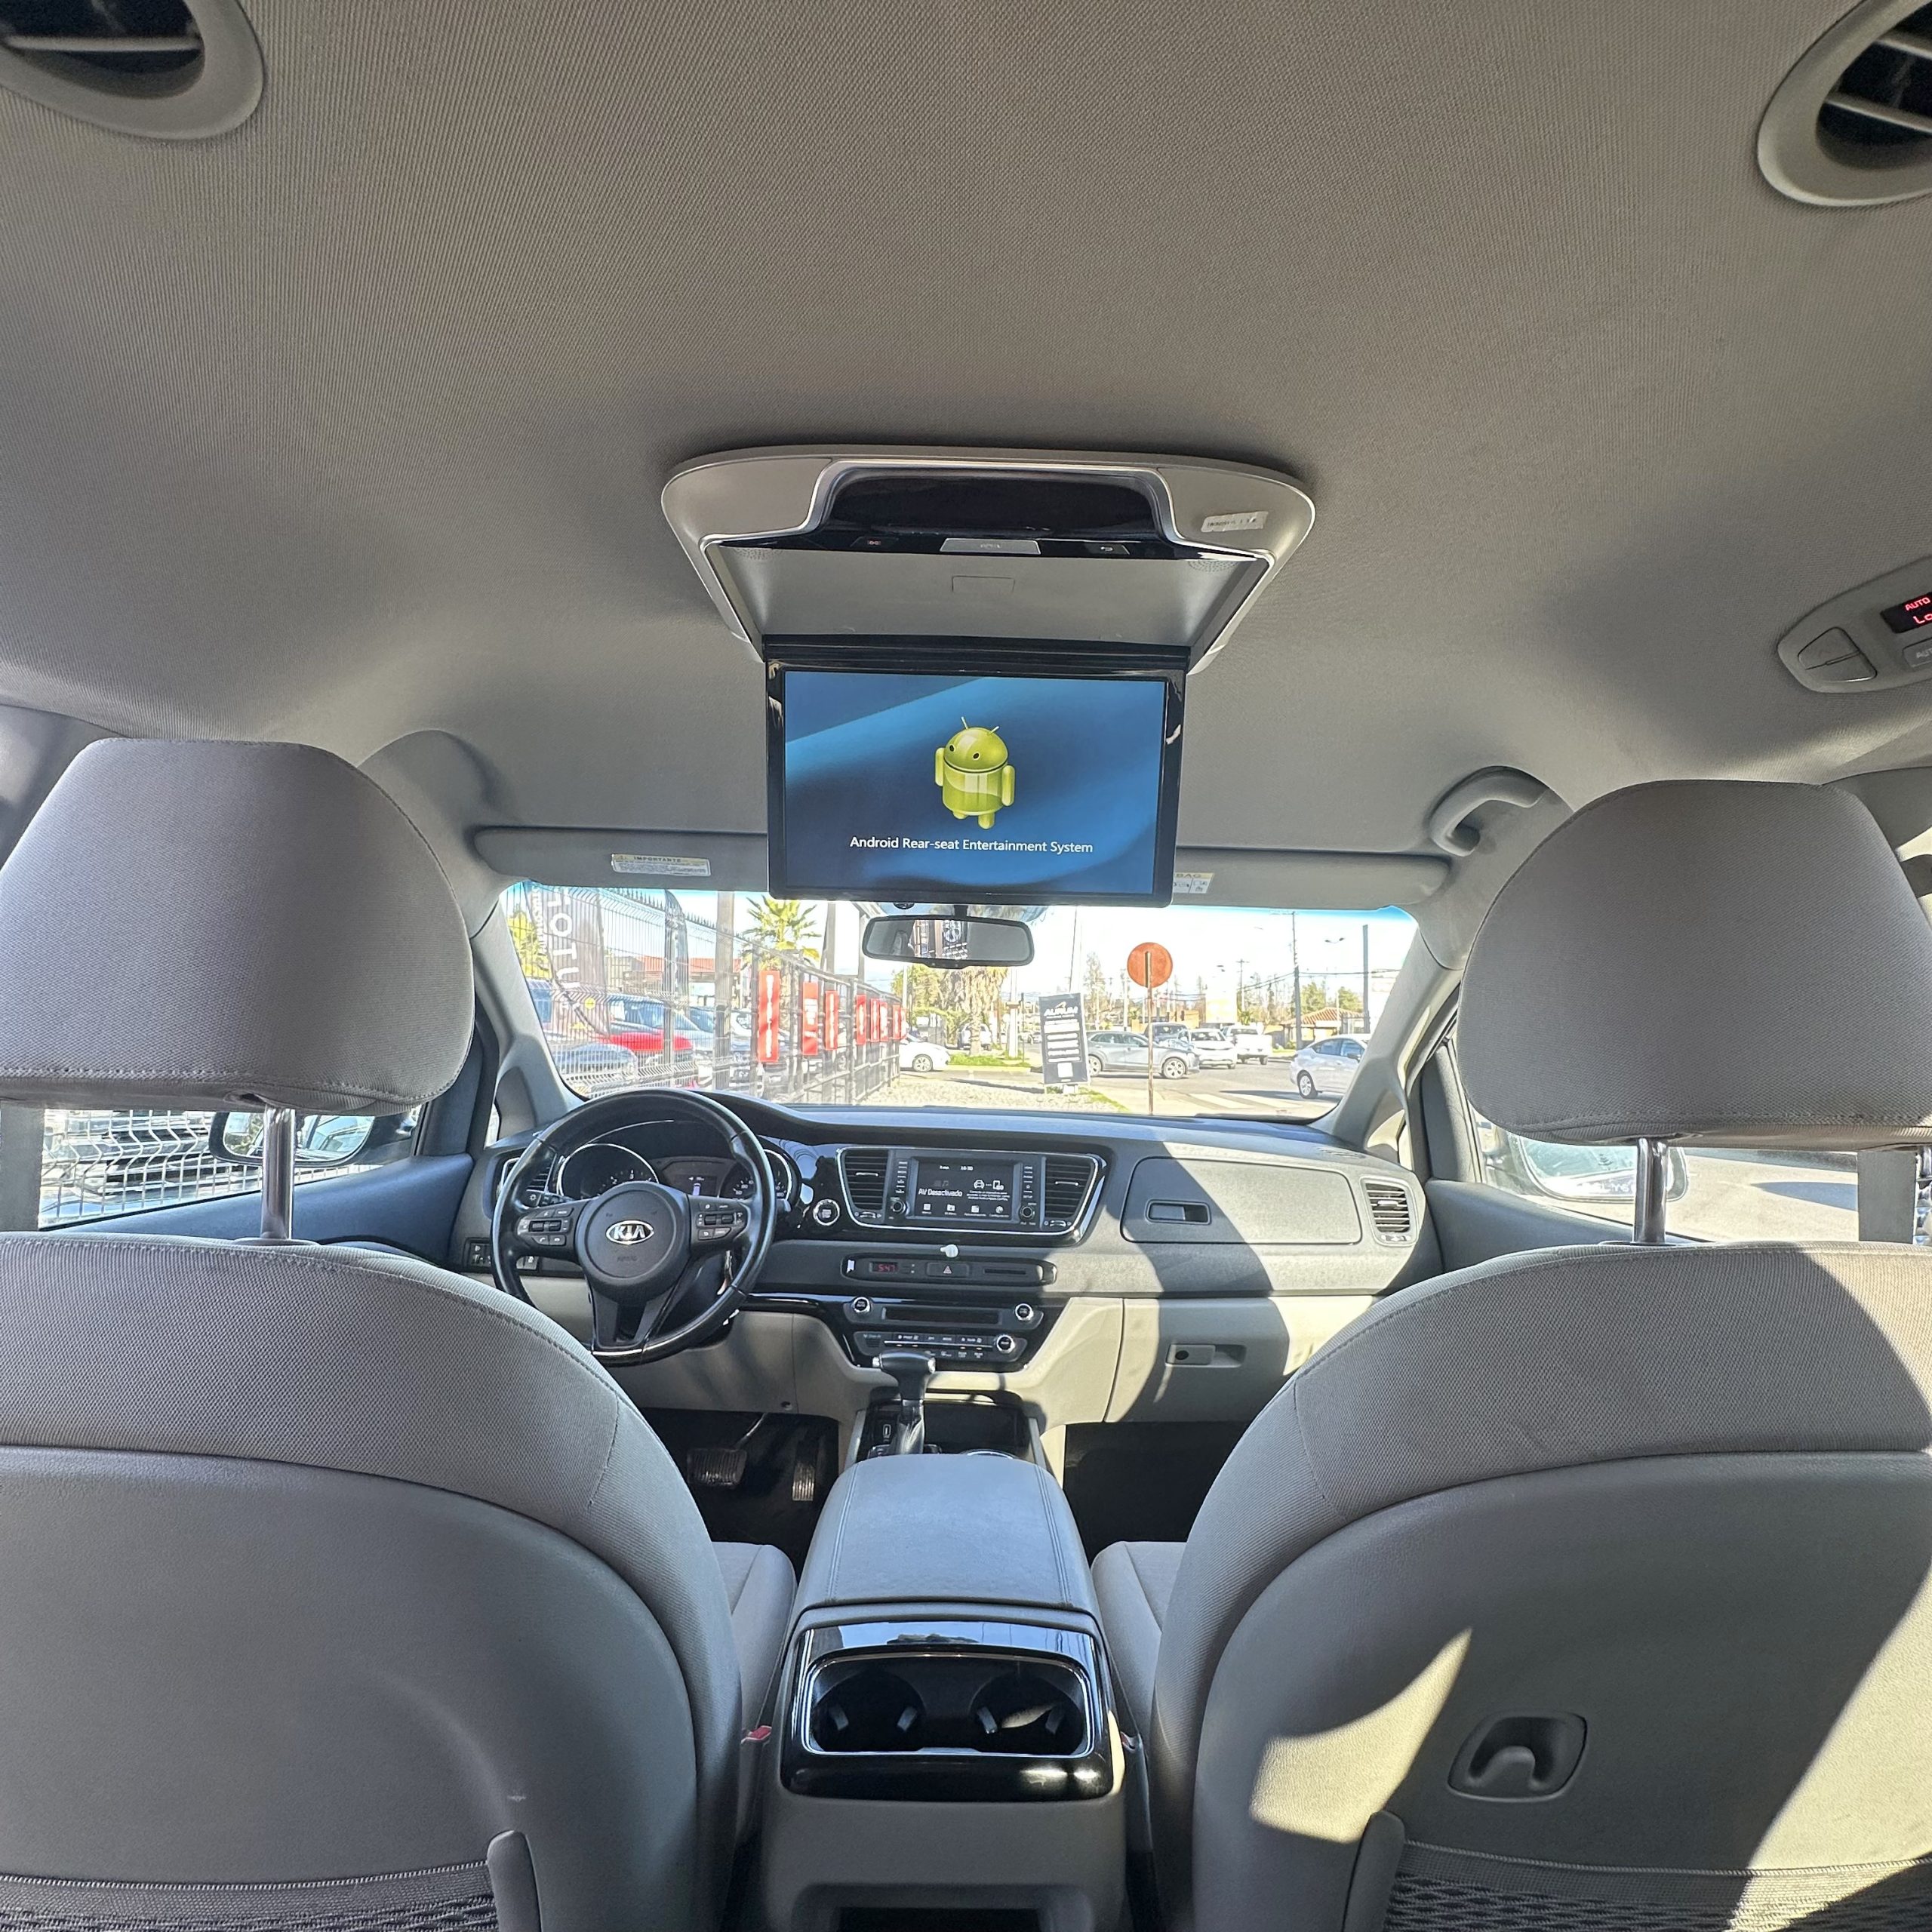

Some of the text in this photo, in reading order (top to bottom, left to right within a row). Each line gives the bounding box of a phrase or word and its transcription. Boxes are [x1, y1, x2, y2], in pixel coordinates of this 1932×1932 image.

[1905, 597, 1931, 611] AUTO
[849, 836, 1094, 855] Android Rear-seat Entertainment System
[633, 855, 682, 863] IMPORTANTE
[613, 1225, 646, 1240] KIA
